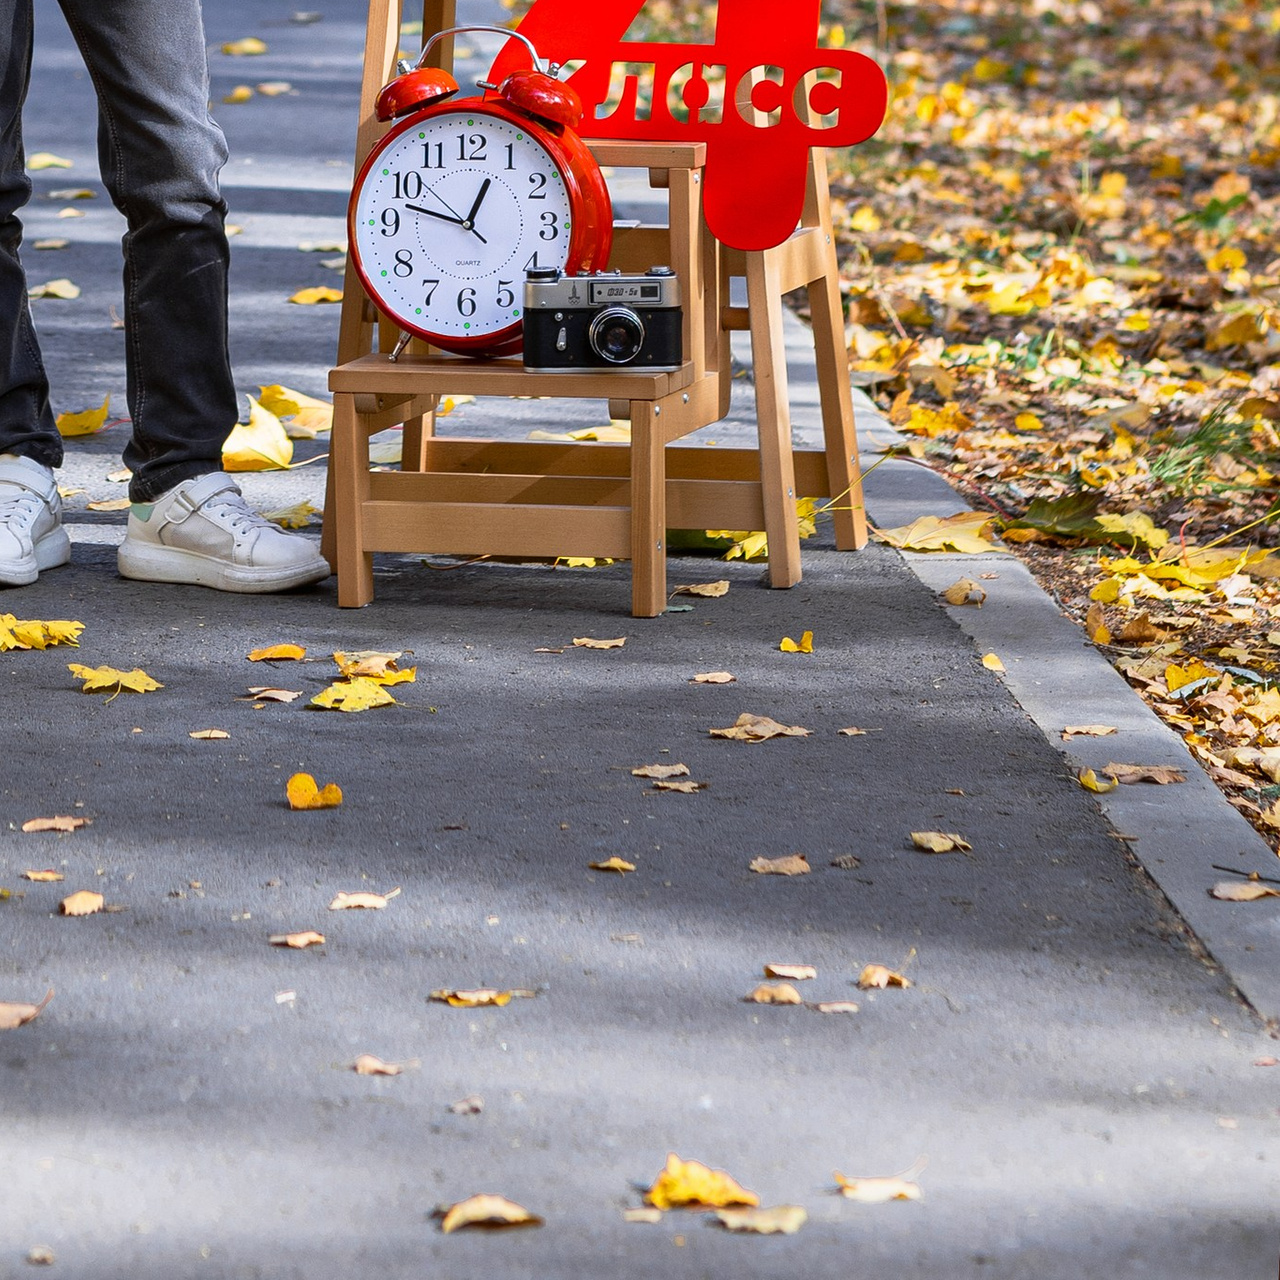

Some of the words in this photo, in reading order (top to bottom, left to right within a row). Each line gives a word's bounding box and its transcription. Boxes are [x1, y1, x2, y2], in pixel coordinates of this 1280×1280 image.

[420, 141, 446, 169] 11
[456, 133, 488, 161] 12
[504, 142, 517, 170] 1
[391, 170, 422, 199] 10
[528, 172, 547, 200] 2
[380, 207, 400, 237] 9
[539, 211, 559, 241] 3
[393, 249, 413, 278] 8
[422, 279, 440, 307] 7
[457, 287, 477, 317] 6
[496, 279, 515, 308] 5
